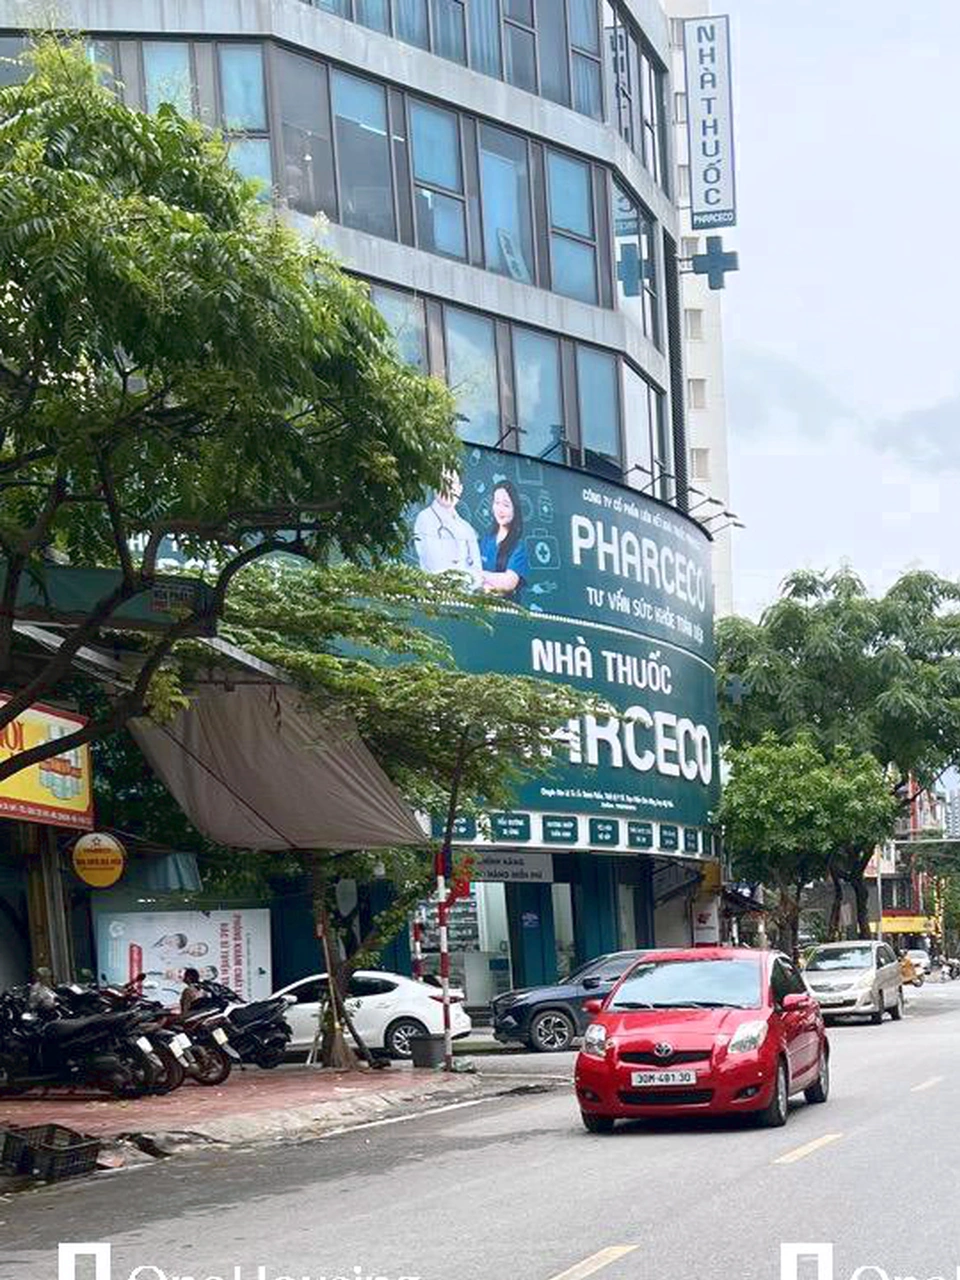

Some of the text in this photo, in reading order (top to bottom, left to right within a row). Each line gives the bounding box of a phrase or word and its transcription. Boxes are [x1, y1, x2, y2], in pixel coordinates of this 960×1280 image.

[697, 25, 721, 205] NHÀ THUỐC
[571, 514, 706, 613] PHARCECO
[586, 586, 605, 608] TƯ
[608, 588, 631, 615] VẤN
[632, 597, 654, 620] SỨC
[531, 635, 673, 695] NHÀ THUỐC
